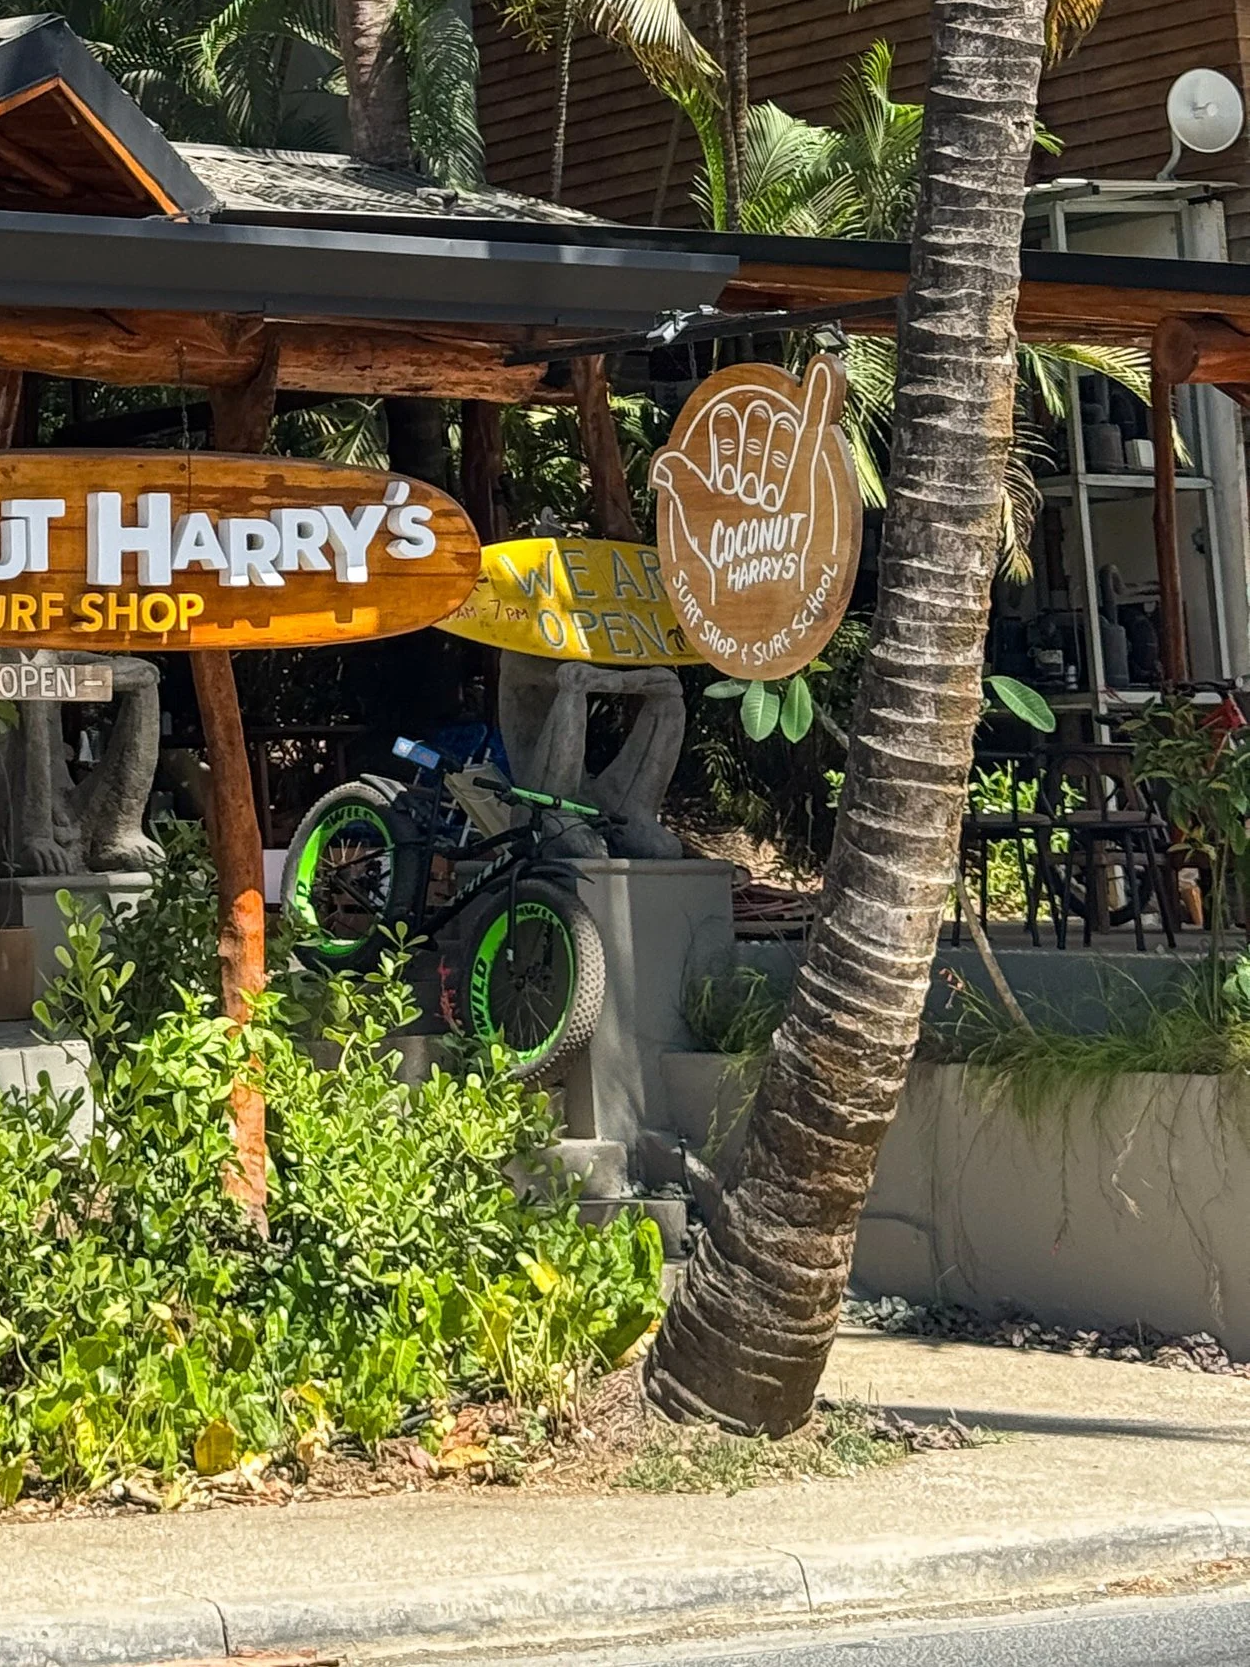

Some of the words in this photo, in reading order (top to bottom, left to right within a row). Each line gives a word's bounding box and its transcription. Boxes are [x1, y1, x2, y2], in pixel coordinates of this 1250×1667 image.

[86, 481, 437, 586] HARRY'S
[710, 512, 808, 569] COCONUT
[498, 548, 598, 600] WE
[611, 548, 663, 602] AR
[726, 552, 799, 592] HARRY'S
[71, 592, 205, 632] SHOP
[537, 608, 673, 658] OPEN
[672, 569, 704, 629] SURF
[699, 619, 738, 660] SHOP
[752, 628, 792, 666] SURF
[791, 563, 838, 640] SCHOOL
